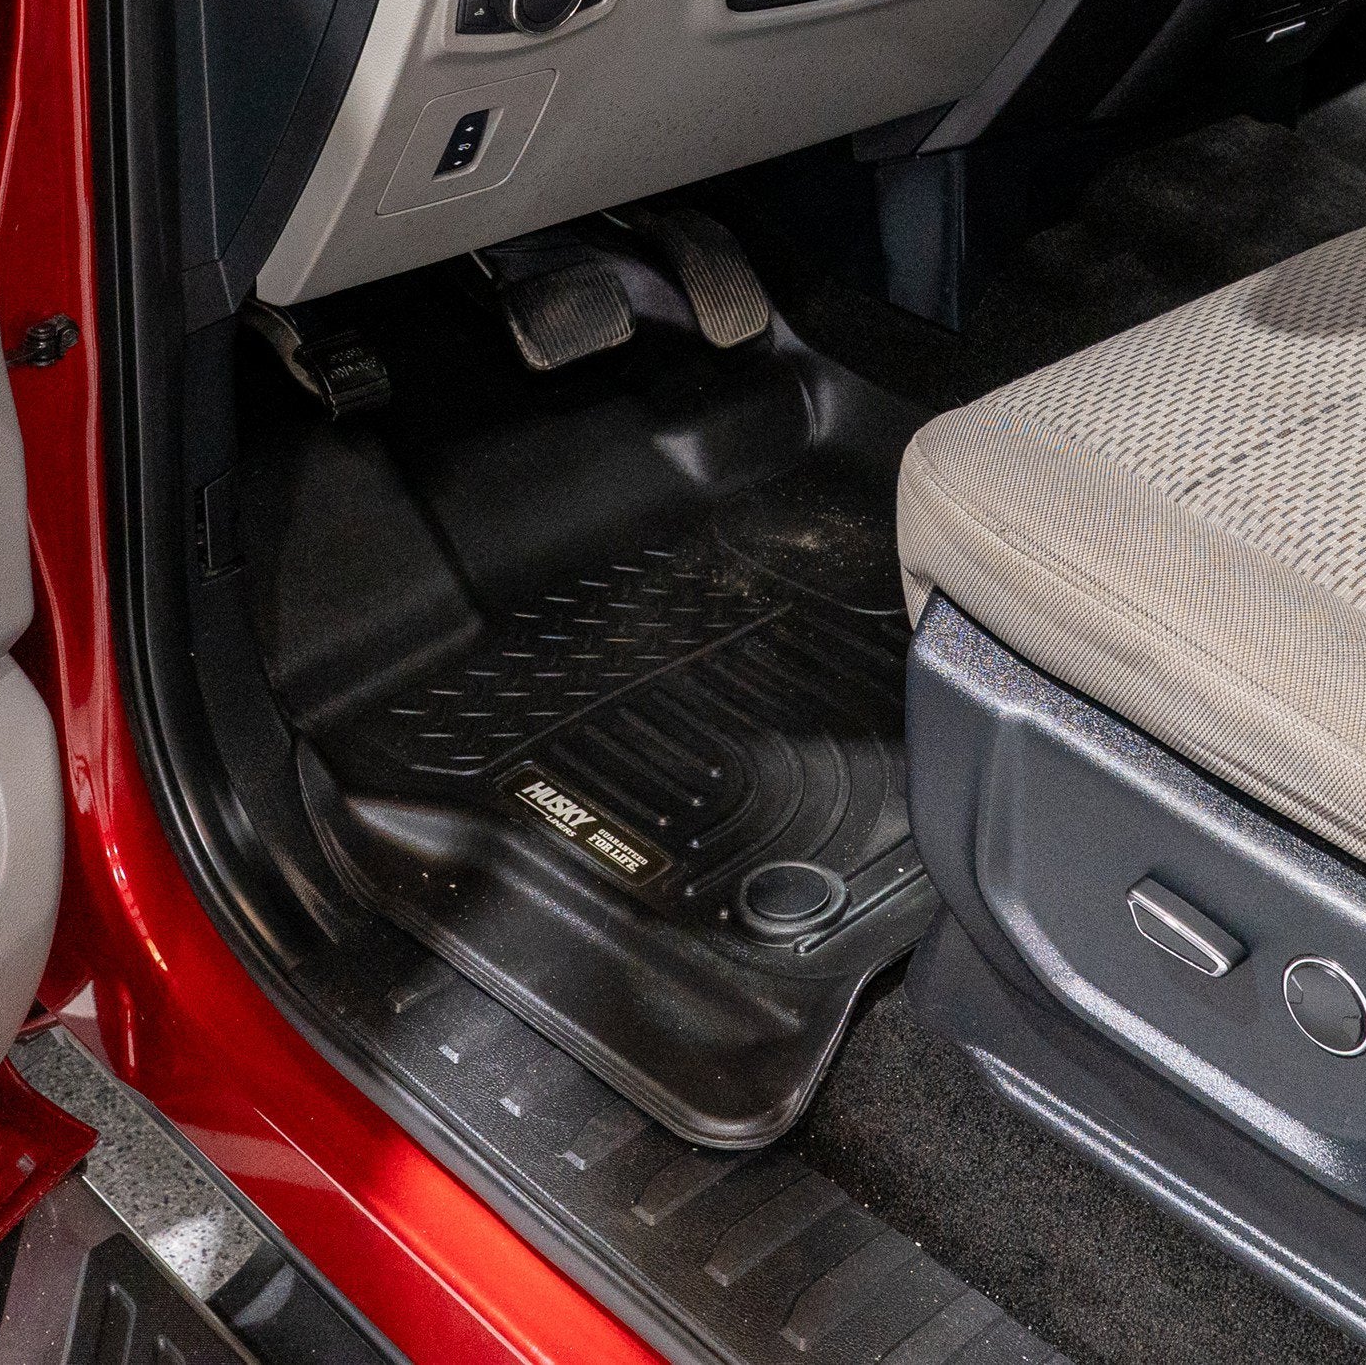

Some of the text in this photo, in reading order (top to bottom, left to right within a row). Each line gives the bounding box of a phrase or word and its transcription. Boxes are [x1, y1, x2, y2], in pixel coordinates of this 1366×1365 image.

[521, 780, 597, 828] HUSKY
[545, 815, 577, 837] LINERS
[587, 833, 613, 853] FOR
[597, 828, 649, 866] GUARANTEED
